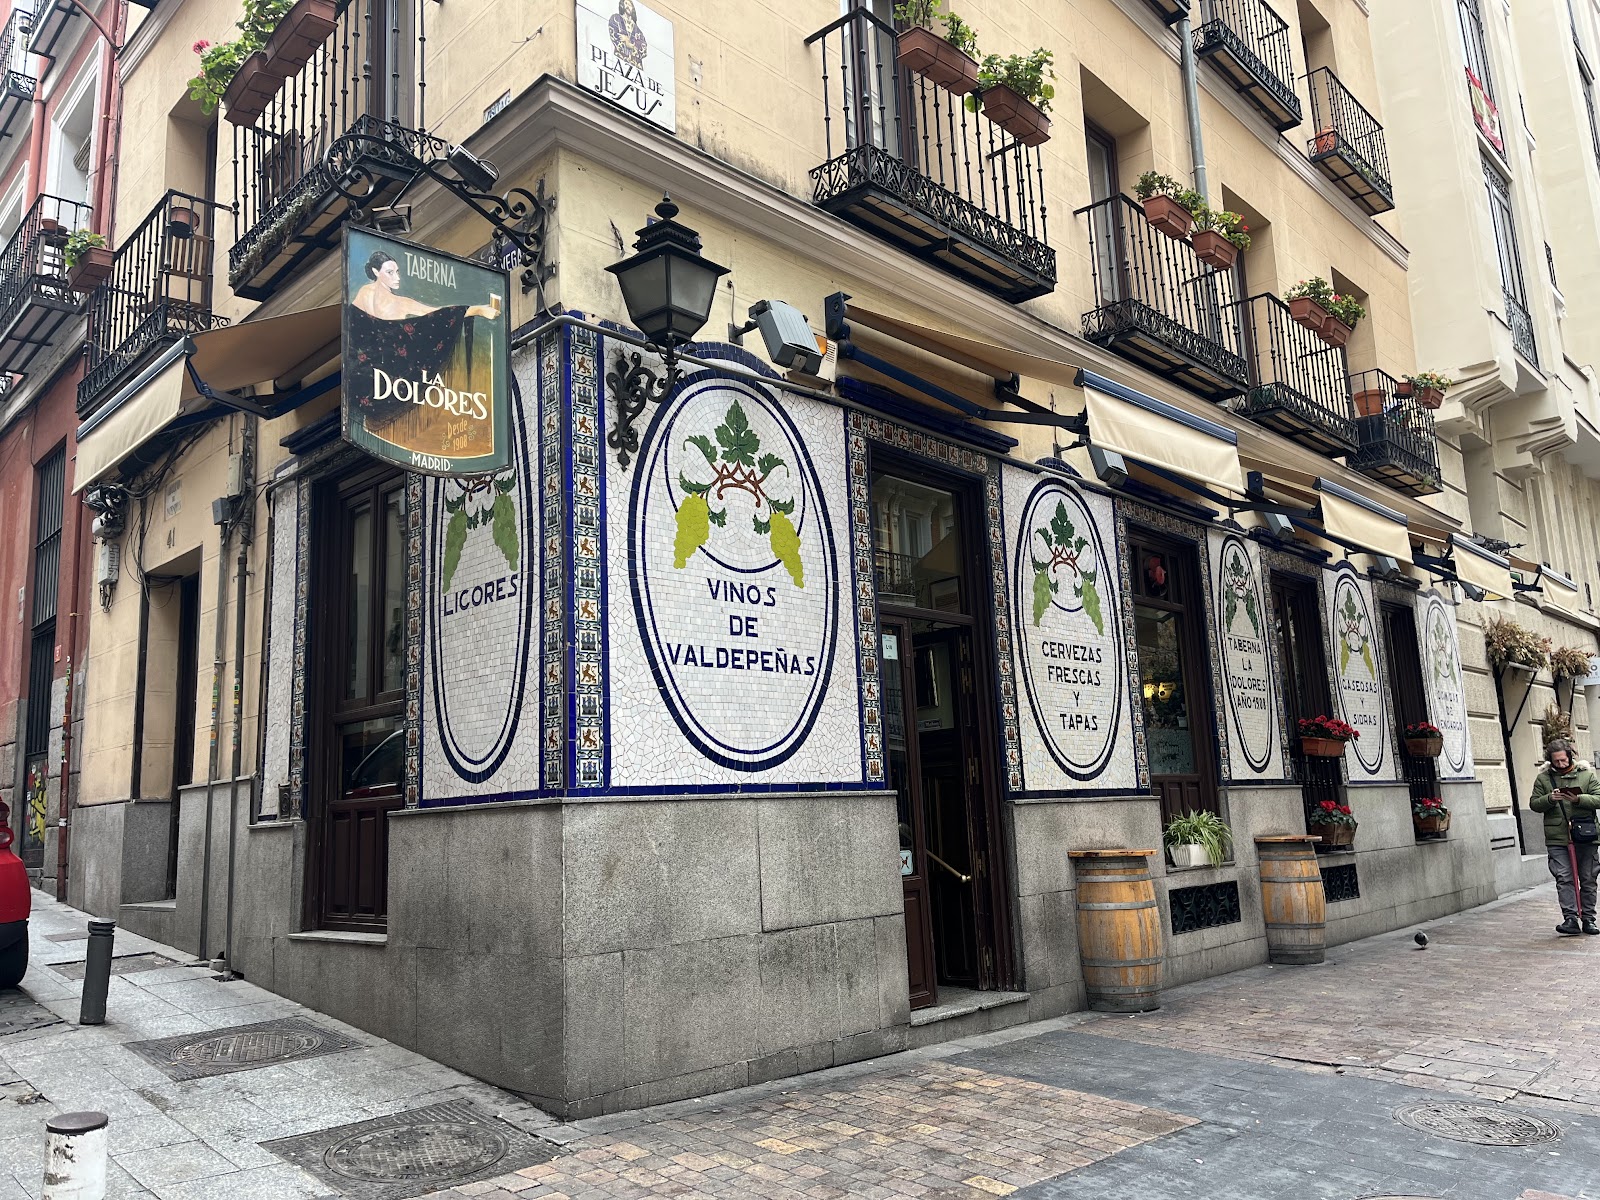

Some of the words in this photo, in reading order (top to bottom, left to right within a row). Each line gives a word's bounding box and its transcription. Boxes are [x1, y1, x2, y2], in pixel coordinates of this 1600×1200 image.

[590, 44, 646, 88] PLAZA
[648, 77, 664, 96] DE
[594, 67, 662, 115] JESUS
[404, 252, 457, 289] TABERNA
[422, 370, 445, 387] LA
[373, 368, 487, 420] DOLORES
[447, 418, 468, 439] Desde
[453, 434, 468, 451] 1908
[411, 452, 451, 471] MADRID
[444, 574, 518, 616] LICORES
[707, 578, 776, 607] VINOS
[729, 615, 758, 637] DE
[1042, 641, 1102, 663] CERVEZAS
[1228, 637, 1262, 654] TABERNA
[667, 643, 815, 675] VALDEPEÑAS
[1242, 658, 1253, 671] LA
[1047, 665, 1101, 686] FRESCAS
[1231, 675, 1266, 691] DOLORES
[1342, 679, 1378, 693] GASEOSAS
[1073, 691, 1080, 707] Y
[1237, 691, 1252, 708] AÑO
[1360, 697, 1365, 708] Y
[1060, 713, 1098, 730] TAPAS
[1353, 714, 1377, 726] SIDRAS
